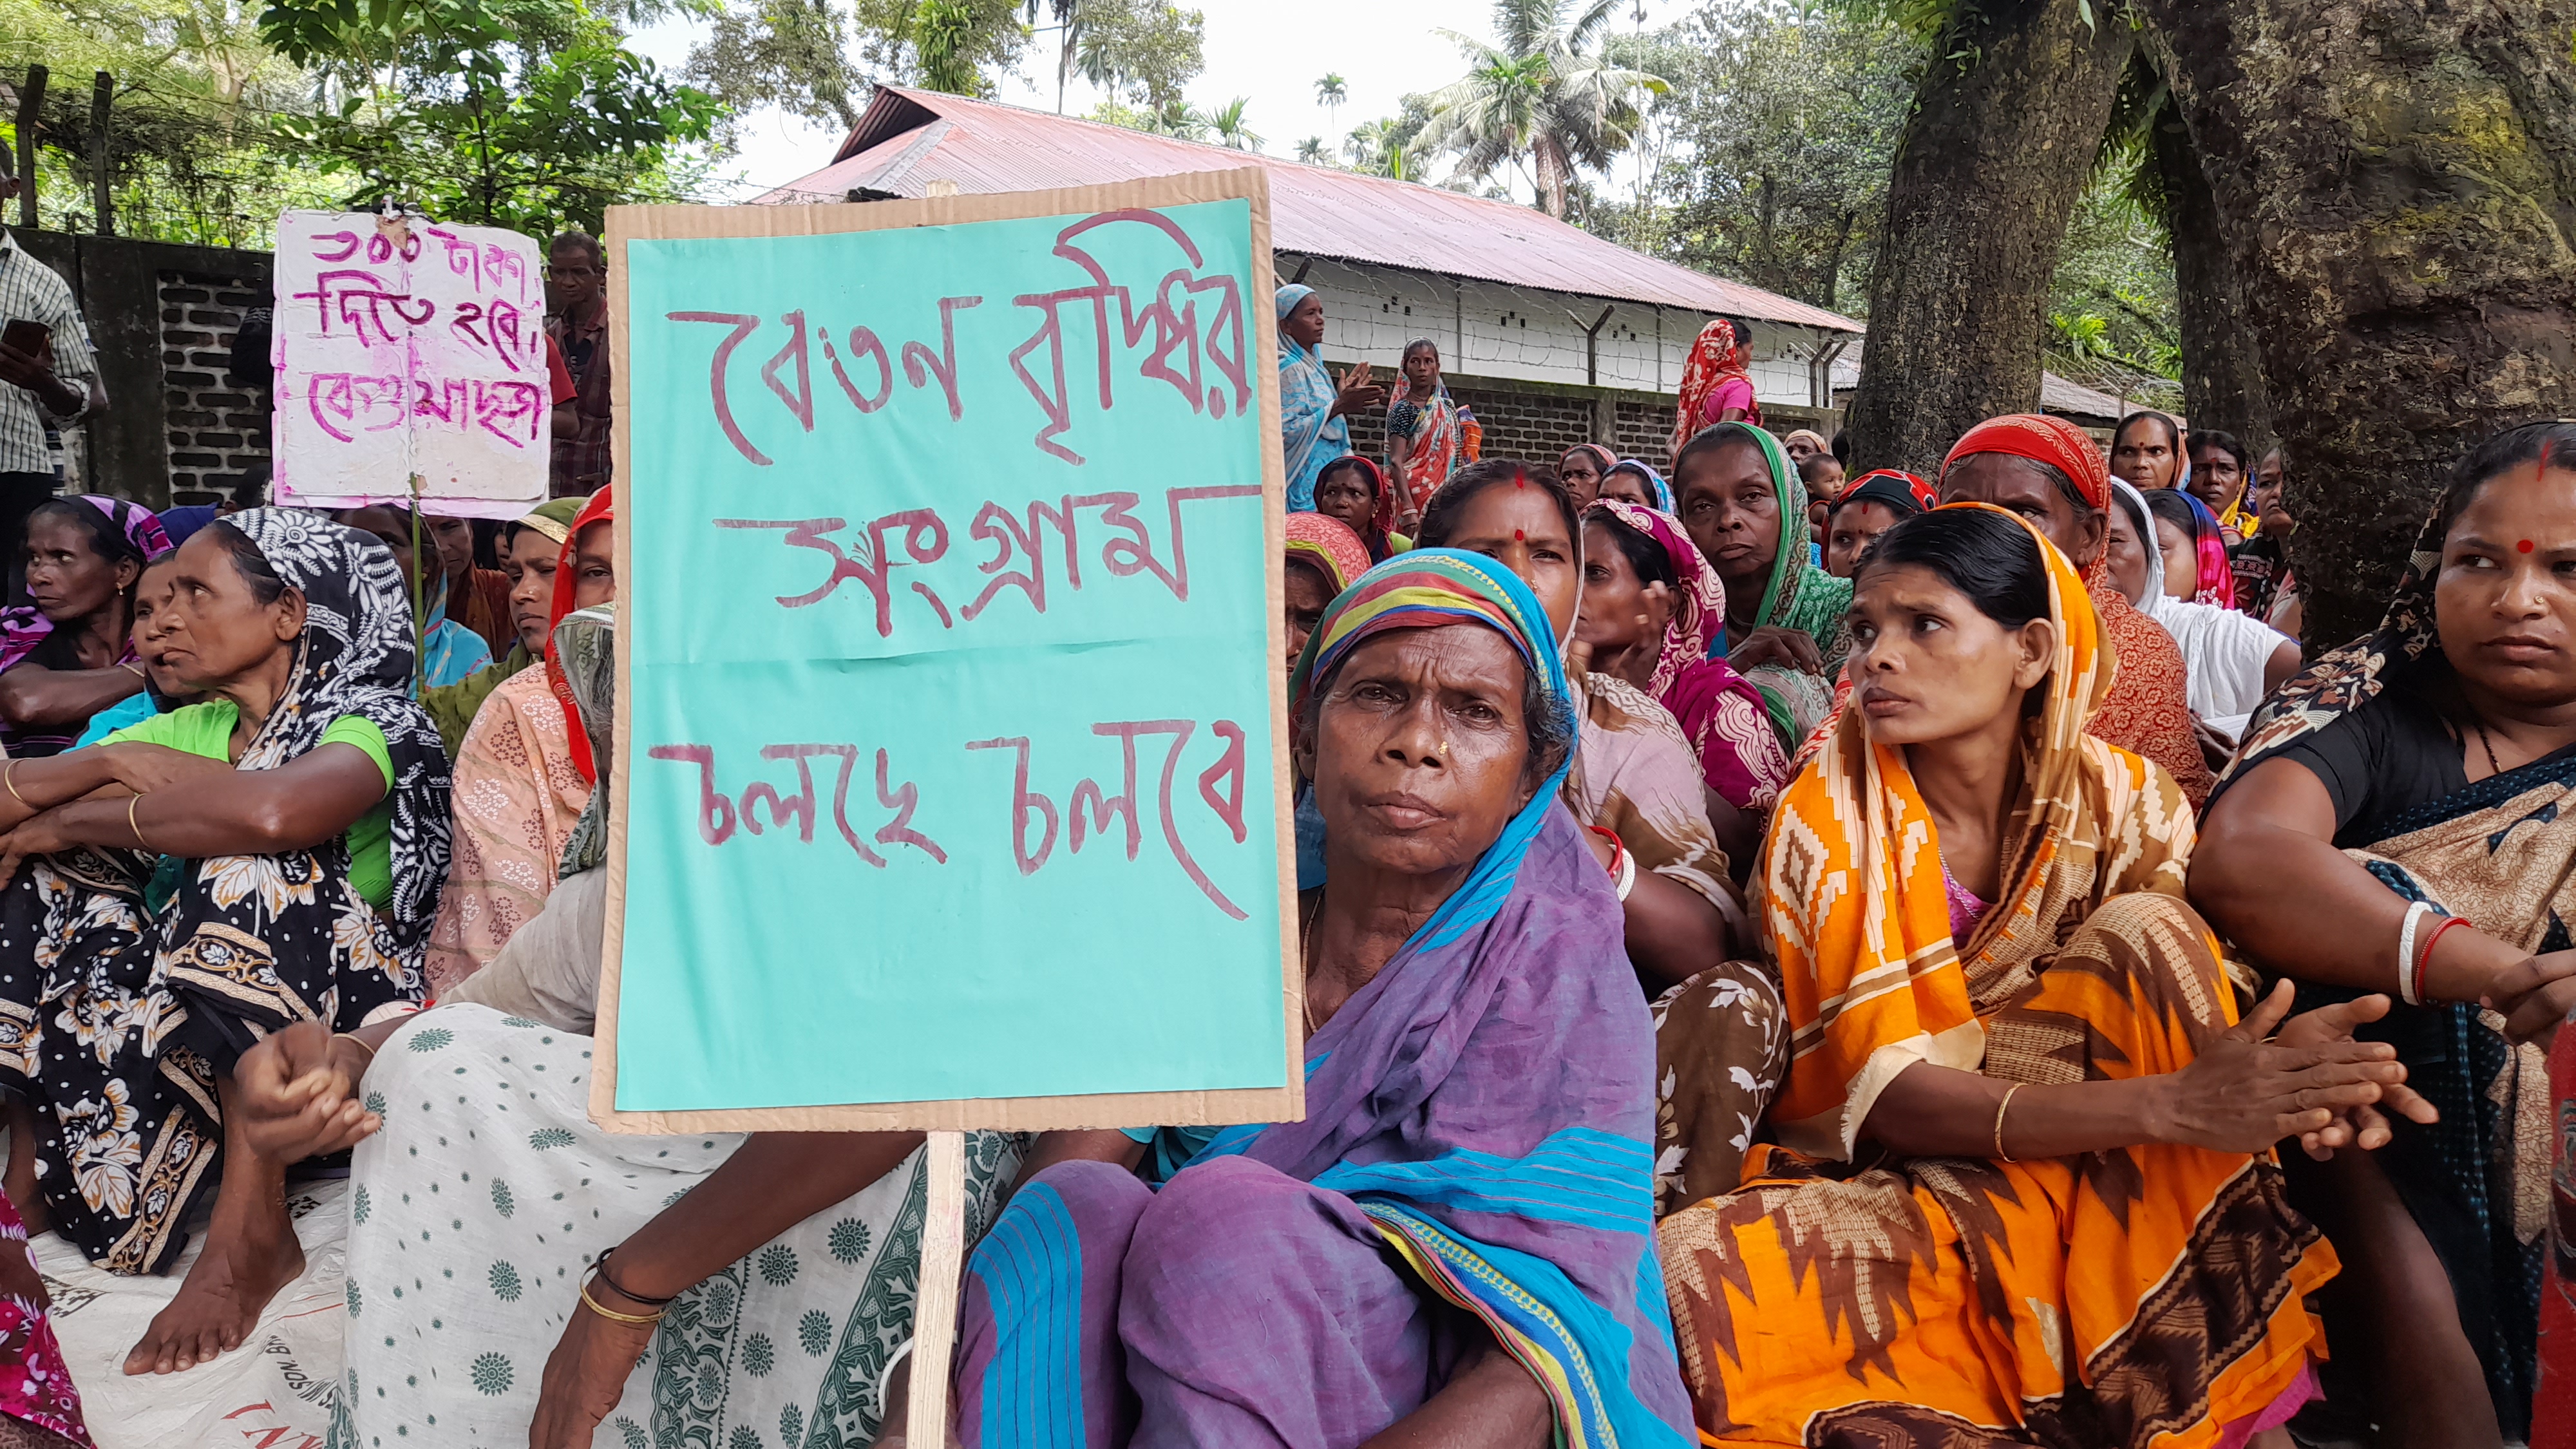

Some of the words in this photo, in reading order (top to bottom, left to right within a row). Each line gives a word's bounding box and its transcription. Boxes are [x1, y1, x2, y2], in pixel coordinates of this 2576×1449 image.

[292, 269, 436, 349] দিতে
[425, 227, 526, 304] টাকা
[665, 294, 983, 466] বেতন
[1009, 207, 1251, 466] বৃদ্ধির
[712, 484, 1262, 638] সংগ্রাম
[647, 743, 948, 867] চলছে
[965, 719, 1251, 920] চলবে
